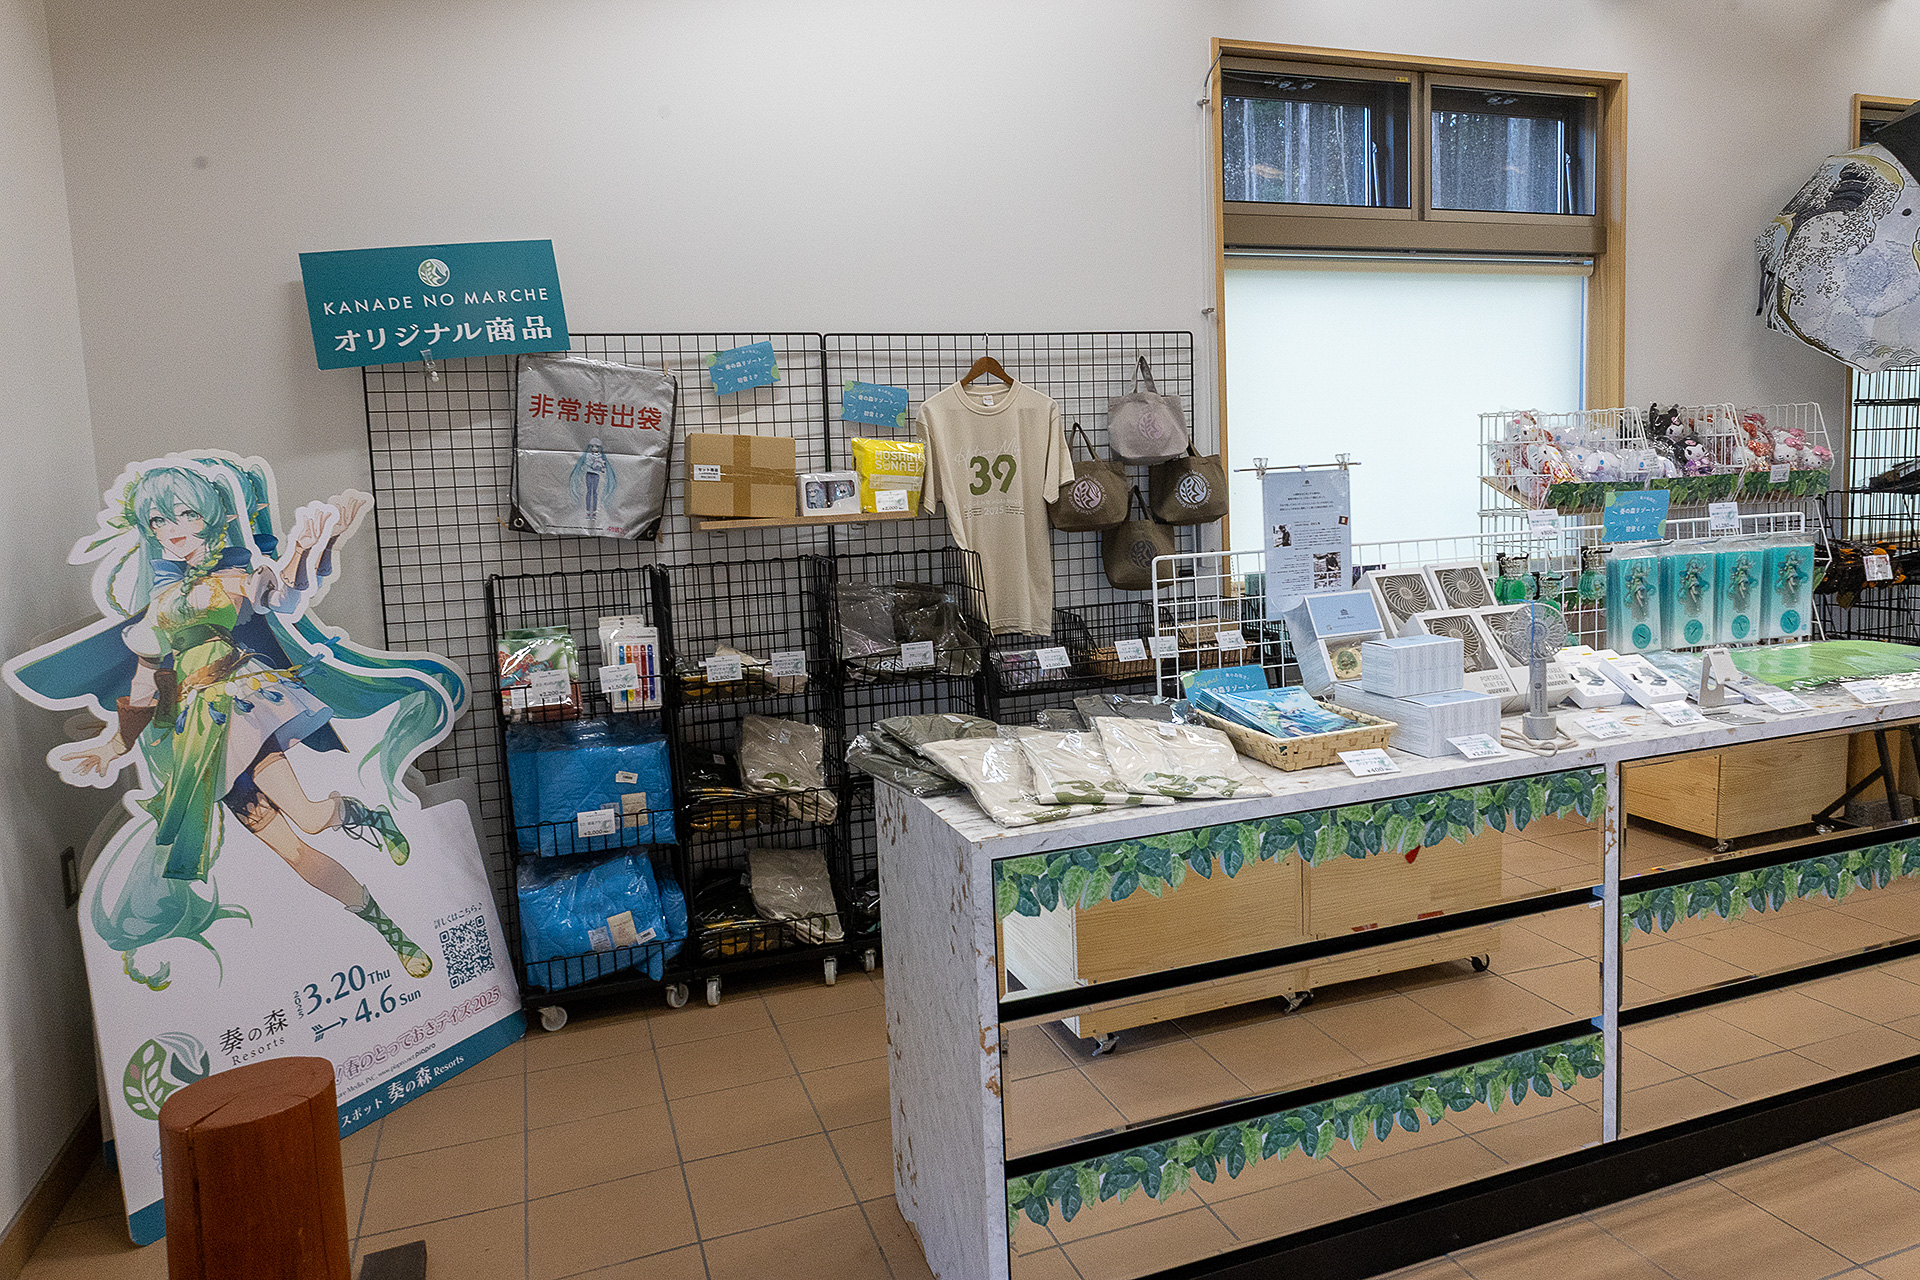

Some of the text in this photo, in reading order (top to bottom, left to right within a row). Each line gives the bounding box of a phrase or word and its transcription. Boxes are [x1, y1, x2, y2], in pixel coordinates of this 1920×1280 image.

[323, 287, 549, 316] KANADE NO MARCHE
[334, 315, 553, 352] オリジナル商品
[528, 392, 663, 432] 非常持出袋
[969, 454, 1017, 496] 39
[293, 991, 304, 1020] 2025
[303, 965, 391, 1015] 3.20 Thu
[355, 984, 421, 1023] 4.6 Sun
[219, 1009, 289, 1056] 奏の森
[232, 1037, 285, 1065] Resorts
[413, 1042, 436, 1058] piapro
[387, 1065, 433, 1105] 奏の森
[434, 1055, 465, 1077] Resorts
